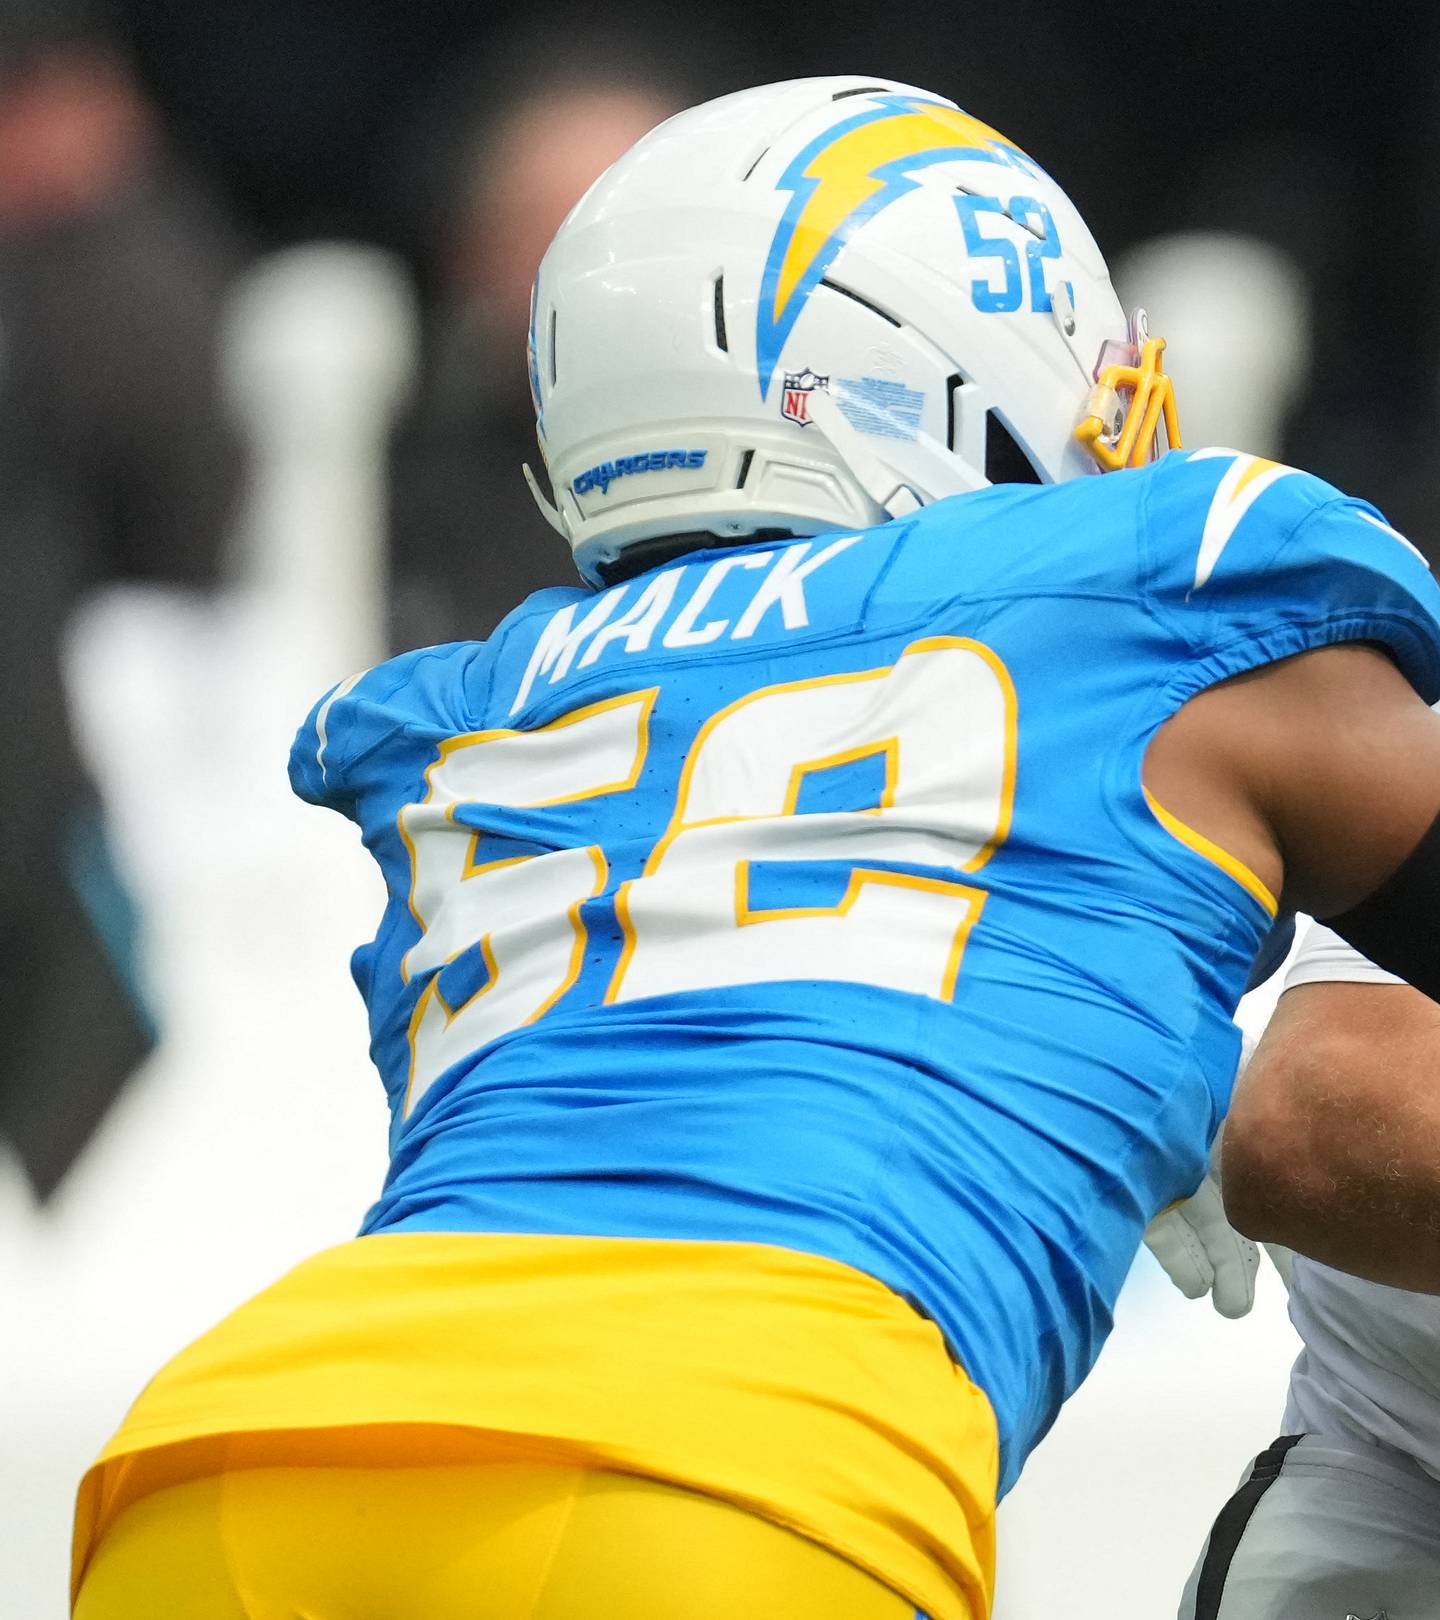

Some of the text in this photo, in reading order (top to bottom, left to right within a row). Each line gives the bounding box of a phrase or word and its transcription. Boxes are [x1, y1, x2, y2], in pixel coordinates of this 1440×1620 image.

[951, 194, 1075, 313] 52
[572, 448, 709, 496] CHARGERS
[509, 536, 863, 716] MACK
[398, 635, 1018, 1120] 52
